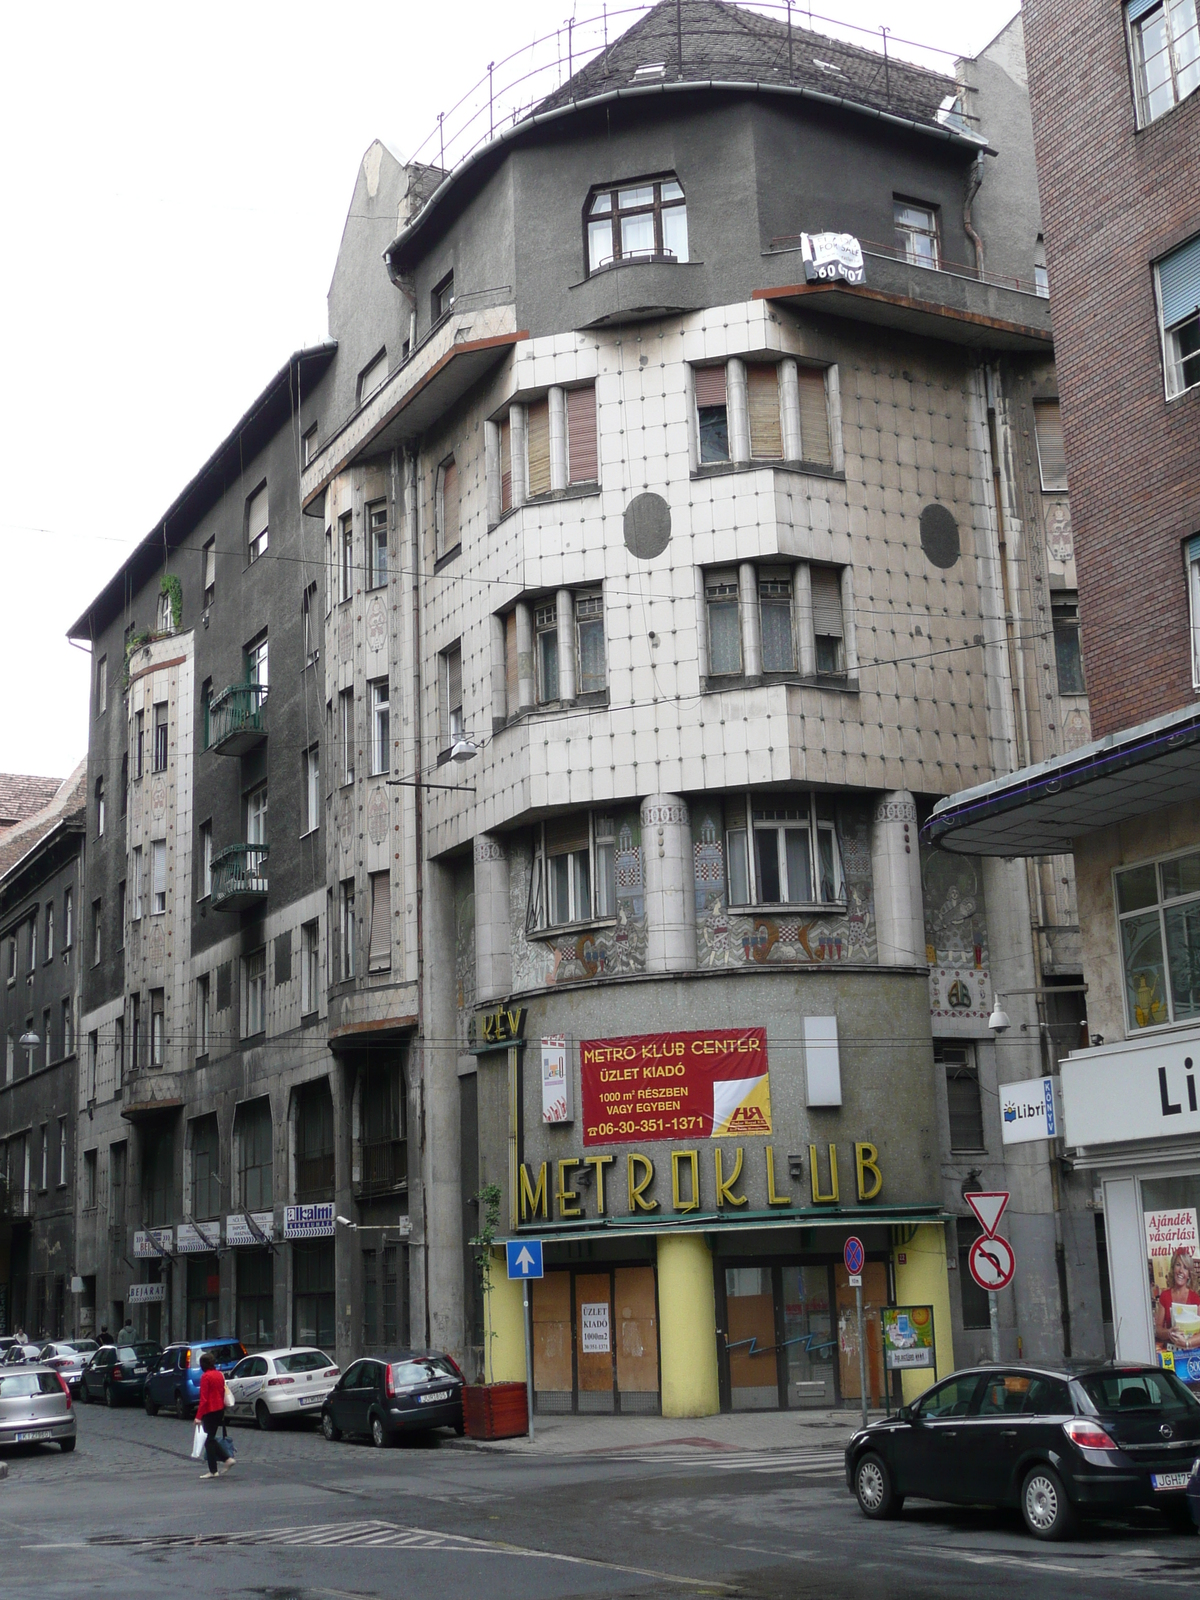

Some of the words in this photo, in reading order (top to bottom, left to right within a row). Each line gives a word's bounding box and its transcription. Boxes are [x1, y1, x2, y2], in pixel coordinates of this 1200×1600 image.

[584, 1046, 637, 1064] METRO
[642, 1042, 685, 1059] KLUB
[691, 1038, 761, 1055] CENTER
[600, 1067, 640, 1083] ÜZLET
[643, 1062, 686, 1078] KIADÓ
[599, 1092, 621, 1103] 1000
[637, 1086, 689, 1100] RÉSZBEN
[1158, 1056, 1198, 1117] Li
[606, 1103, 634, 1116] VAGY
[636, 1101, 681, 1113] EGYBEN
[1017, 1101, 1045, 1119] Libri
[1044, 1083, 1054, 1131] KÖNYV
[599, 1116, 704, 1136] 06-30-351-1371
[519, 1142, 883, 1220] METROKLUB
[286, 1204, 333, 1221] alkalmi
[1148, 1212, 1193, 1231] Ajándék
[1149, 1226, 1196, 1243] vásárlási
[1151, 1243, 1196, 1258] utalvány
[130, 1286, 165, 1297] BEJÁRAT
[583, 1306, 608, 1316] ÜZLET
[583, 1319, 608, 1328] KIADÓ
[584, 1332, 608, 1341] 1000m2
